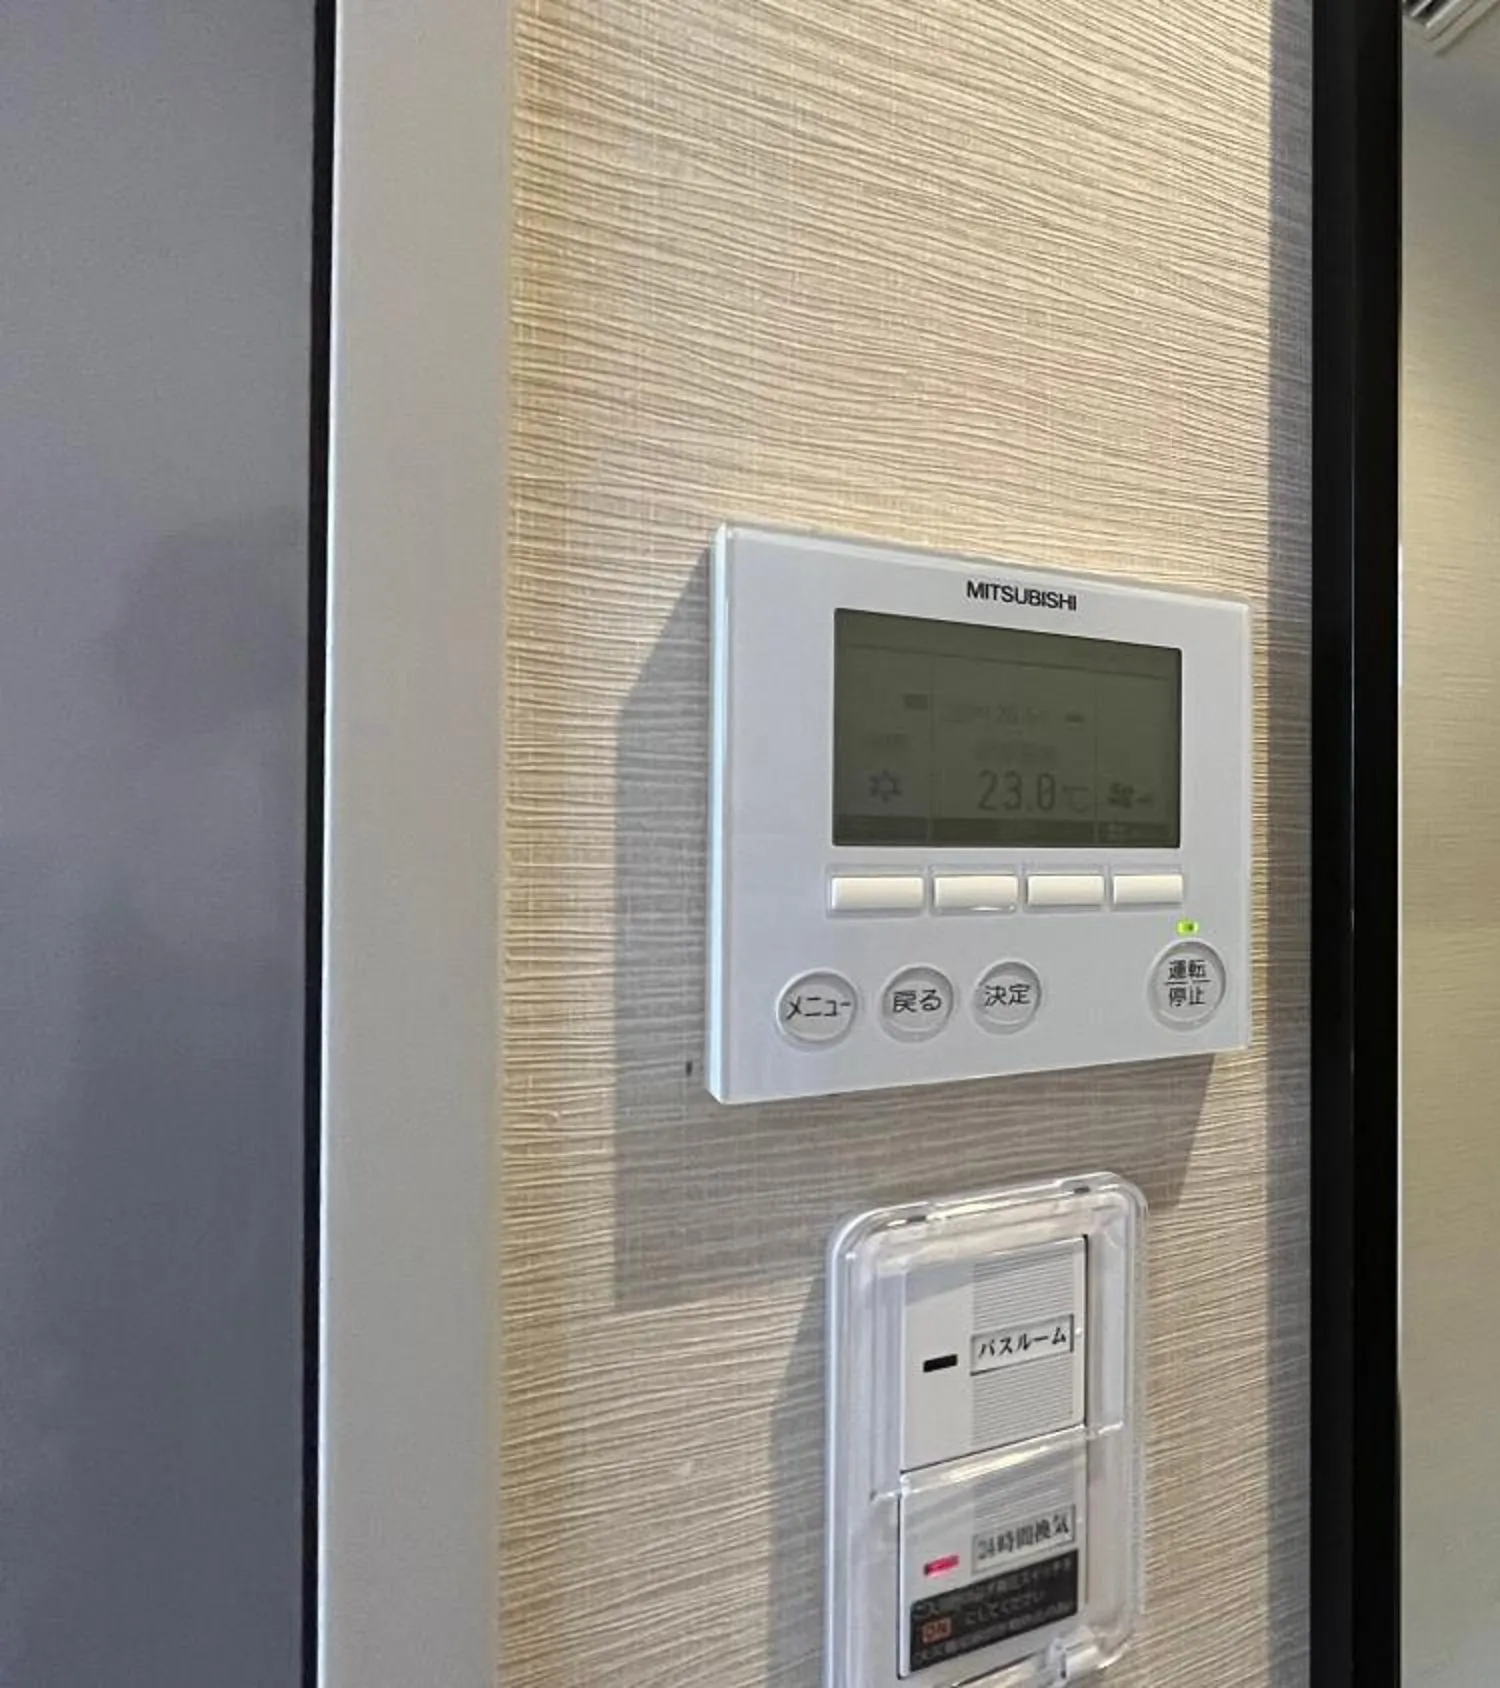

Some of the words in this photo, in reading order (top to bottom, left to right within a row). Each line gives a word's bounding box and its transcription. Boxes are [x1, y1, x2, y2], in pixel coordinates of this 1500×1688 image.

[965, 580, 1078, 611] MITSUBISHI
[1166, 958, 1208, 981] 運転
[892, 988, 944, 1014] 戻る
[984, 983, 1032, 1007] 決定
[1167, 985, 1206, 1008] 停止
[786, 996, 852, 1021] メニュー
[977, 1325, 1067, 1361] バスルーム
